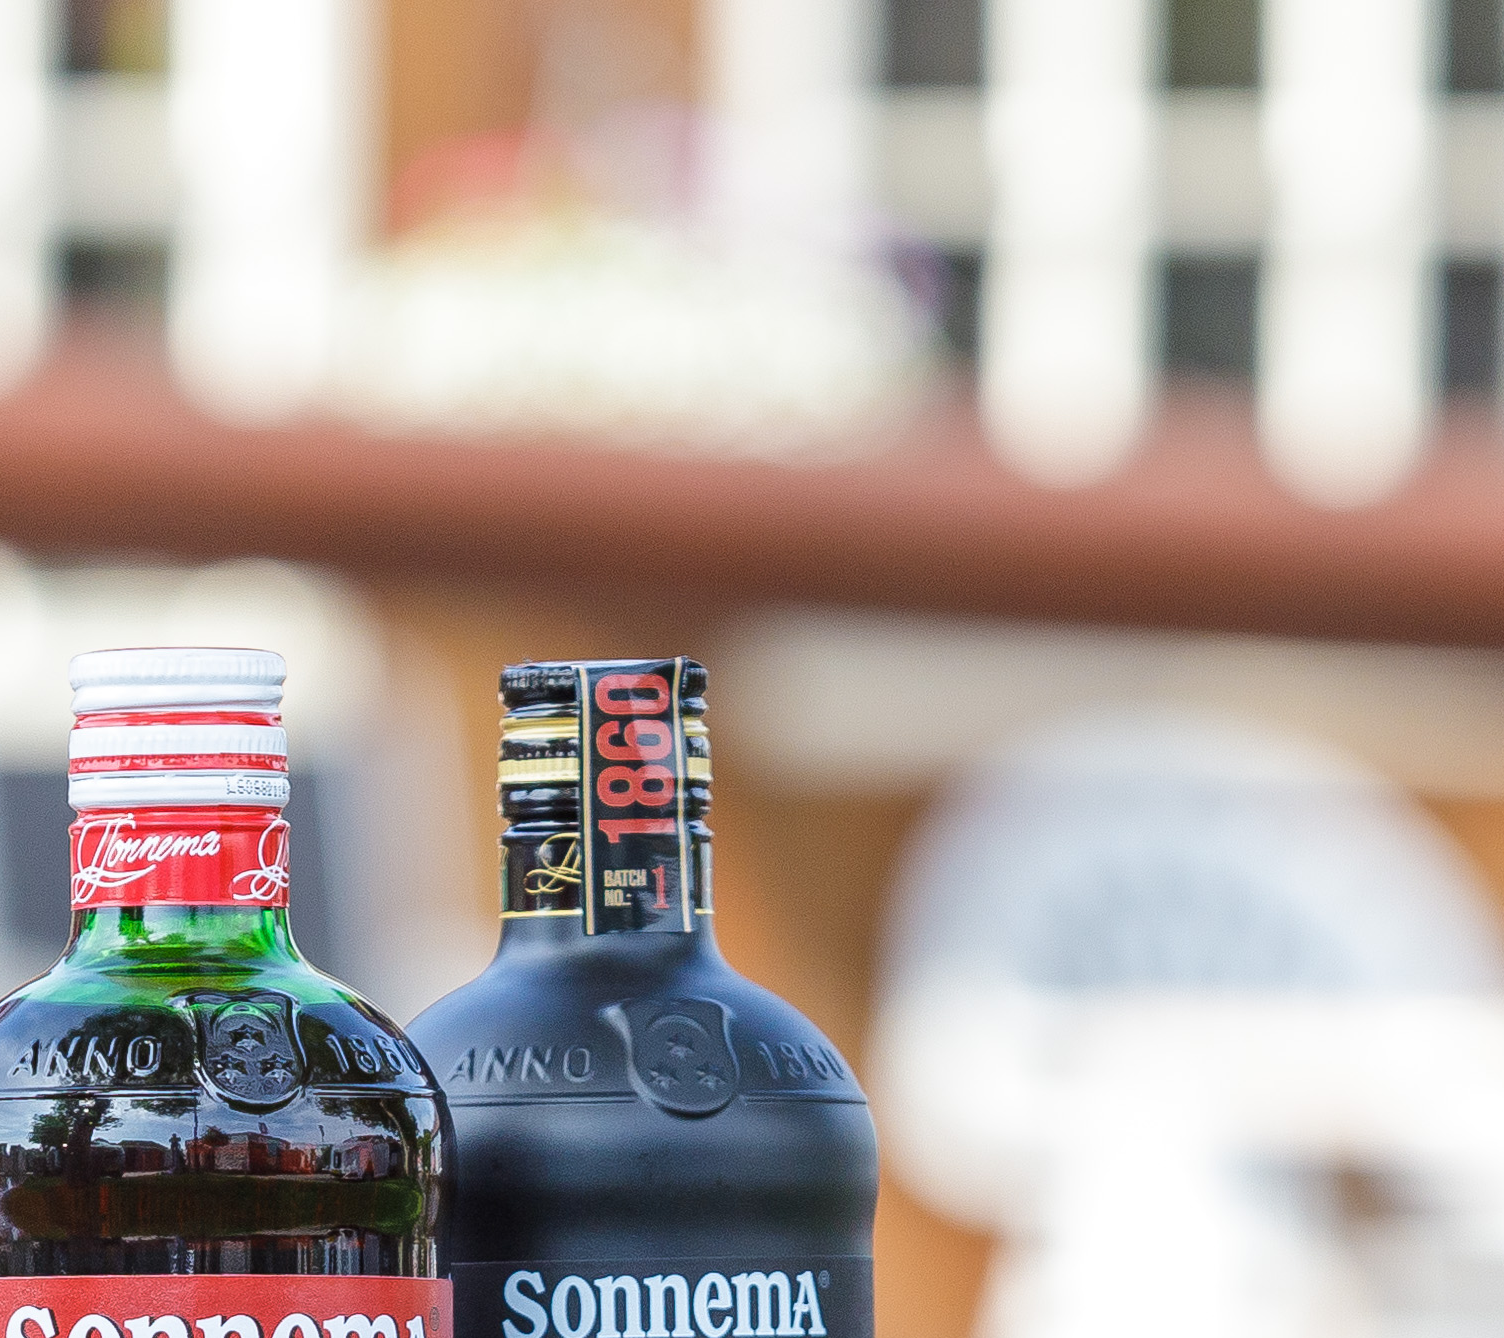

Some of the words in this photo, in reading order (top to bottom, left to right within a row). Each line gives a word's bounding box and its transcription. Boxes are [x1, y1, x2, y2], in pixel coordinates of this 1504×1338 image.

[595, 674, 676, 844] 1860
[603, 869, 648, 887] BATCH
[651, 864, 671, 909] 1
[6, 1035, 163, 1079] ANNO
[324, 1034, 424, 1076] 1860
[446, 1045, 595, 1084] ANNO
[756, 1040, 847, 1082] 1860
